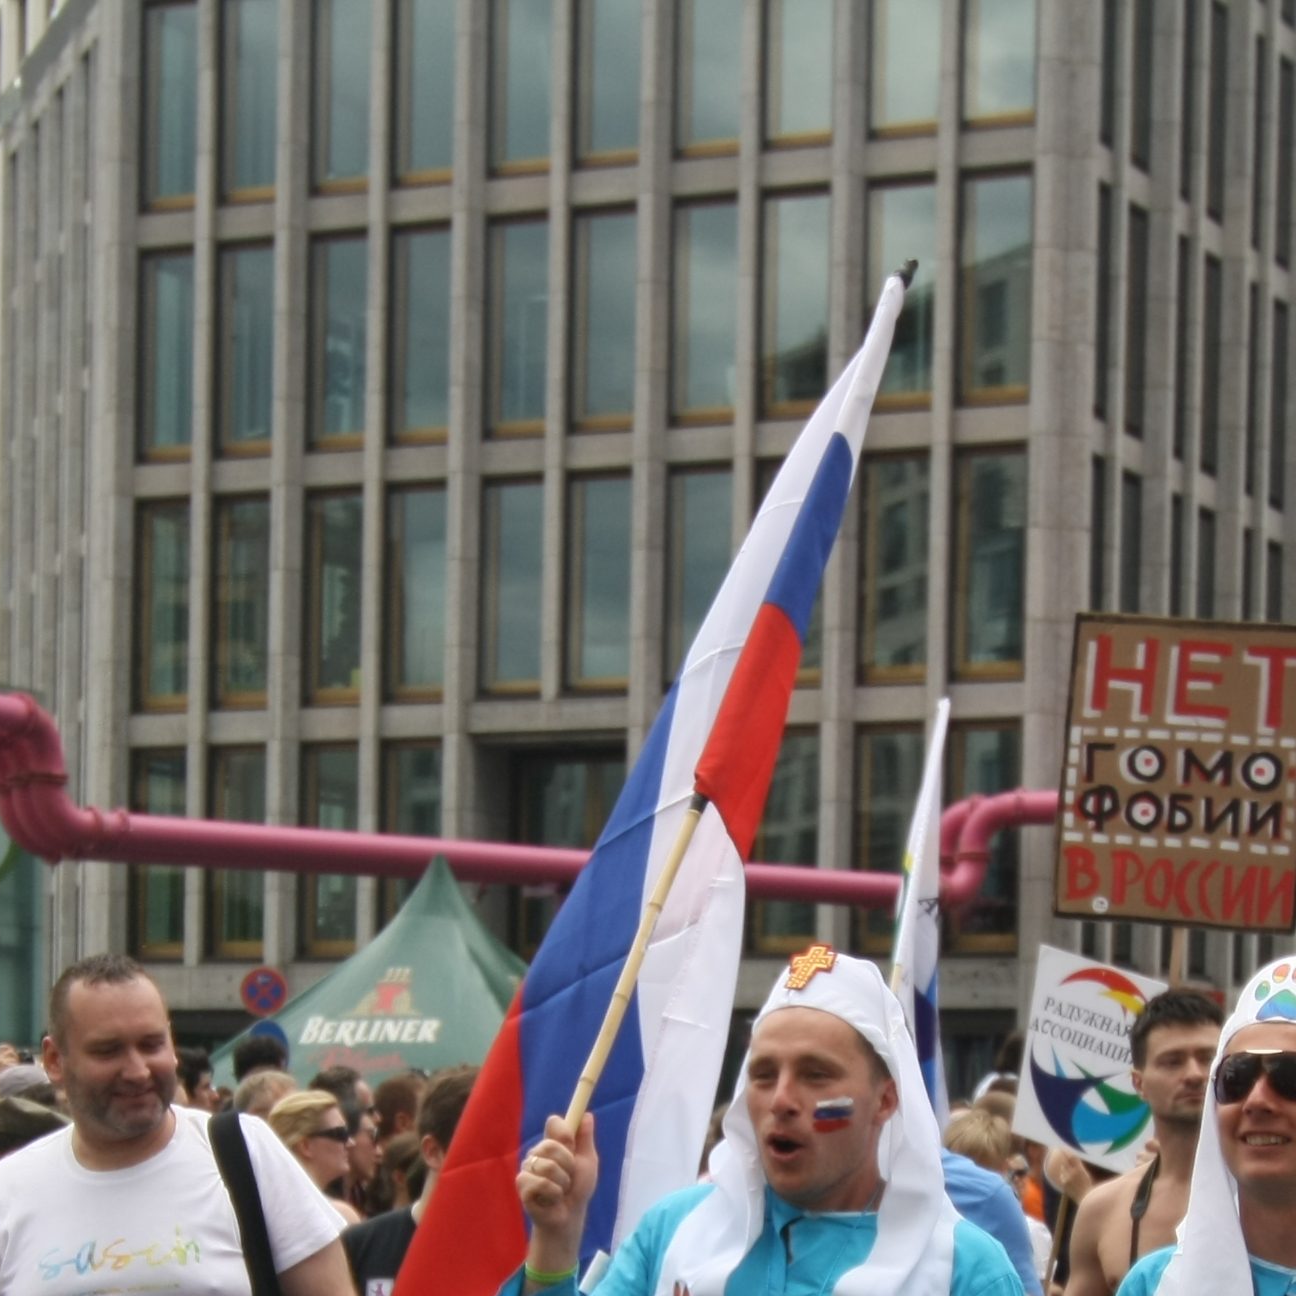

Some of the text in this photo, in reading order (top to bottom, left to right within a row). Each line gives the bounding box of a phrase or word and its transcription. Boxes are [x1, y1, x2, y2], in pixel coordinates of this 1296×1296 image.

[1081, 742, 1284, 793] ГОМО
[1074, 784, 1286, 841] ФОБИИ
[1063, 845, 1296, 928] В РОССИИ
[298, 1015, 442, 1047] BERLINER
[1029, 1016, 1134, 1065] АССОЦИАЦИ
